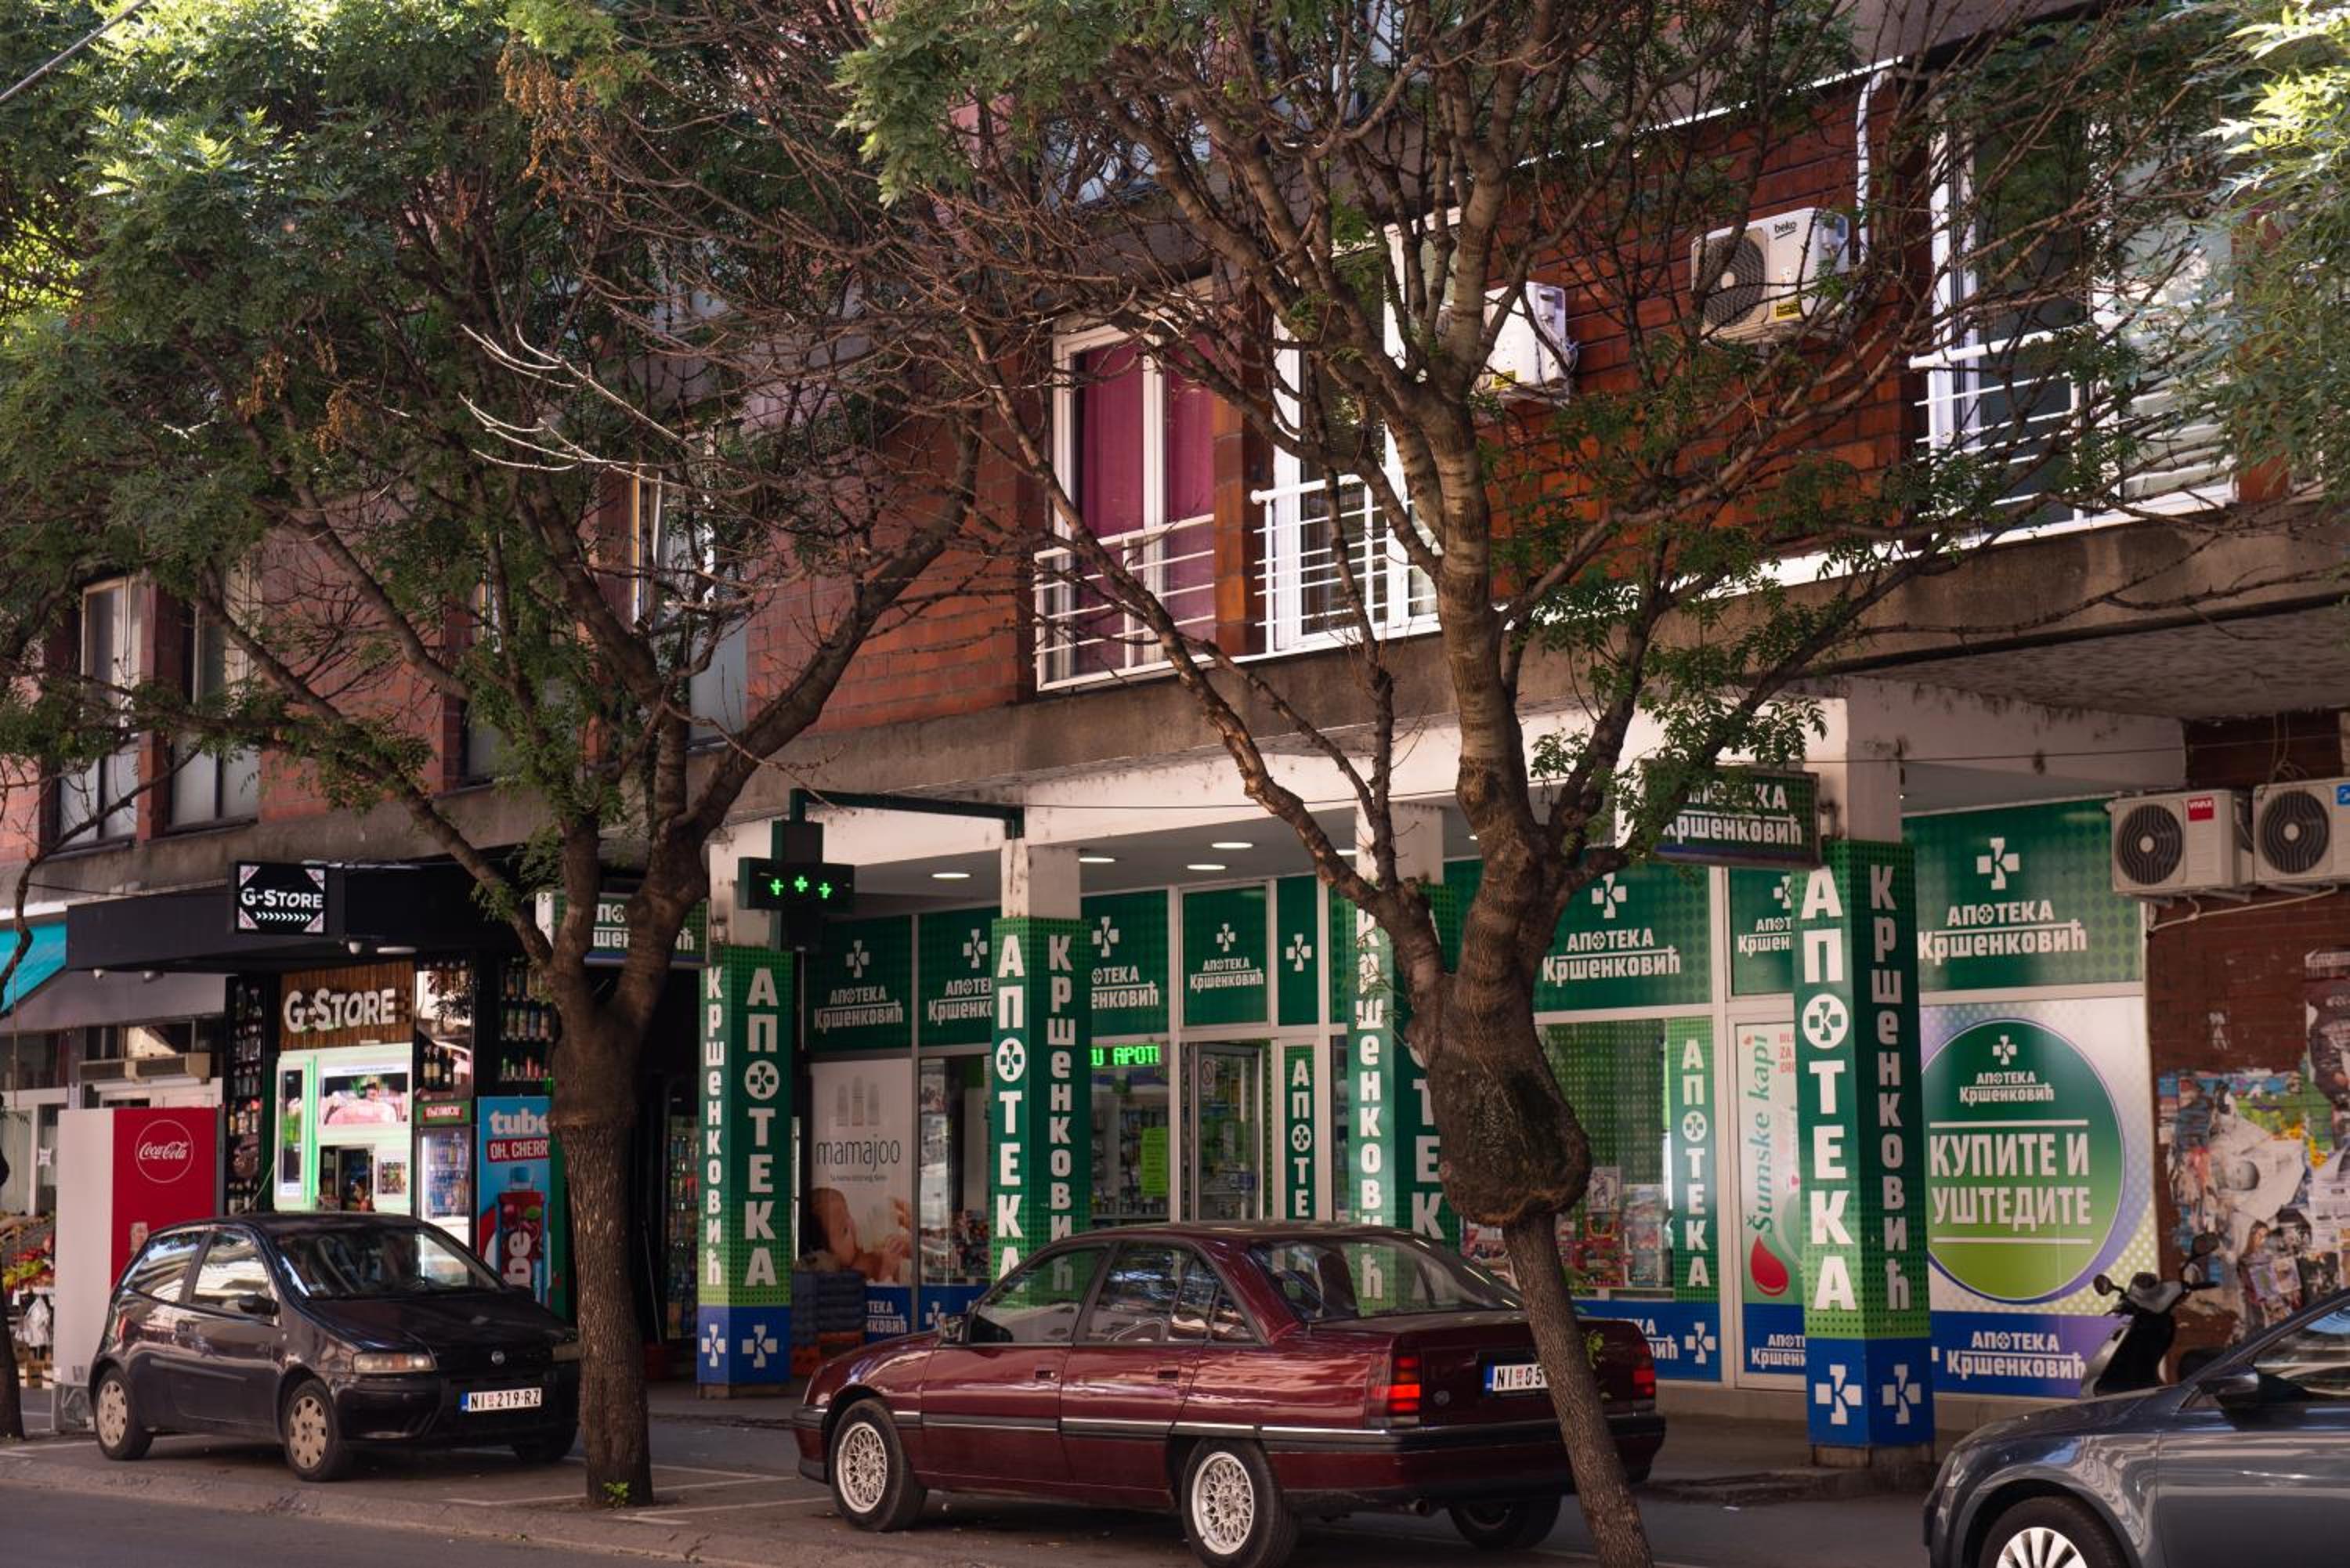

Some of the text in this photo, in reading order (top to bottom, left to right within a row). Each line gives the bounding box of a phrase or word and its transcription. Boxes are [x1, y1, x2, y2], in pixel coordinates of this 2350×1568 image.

[1774, 221, 1797, 233] beko
[240, 887, 324, 908] G-STORE
[1755, 917, 1792, 932] АПОТ
[1947, 900, 2055, 927] АПОТЕКА
[1567, 928, 1654, 952] АПОТЕКА
[1918, 919, 2087, 965] Кршенковић
[1091, 965, 1140, 985] ОТЕКА
[1202, 956, 1250, 971] АПОТЕКА
[1542, 945, 1680, 987] Кршенковић
[945, 977, 992, 995] АПОТЕ
[1190, 966, 1264, 993] Кршенковић
[830, 985, 887, 1004] АПОТЕКА
[1091, 980, 1159, 1010] енковић
[284, 988, 396, 1033] G-STORE
[815, 999, 903, 1034] Кршенковић
[1747, 1034, 1776, 1101] kapi
[1976, 1071, 2036, 1085] АПОТЕКА
[1802, 865, 1856, 1310] АПОТЕКА
[1870, 863, 1911, 1310] Кршенковић
[1959, 1082, 2055, 1107] Кршенковић
[705, 966, 725, 1286] Кршенковић
[744, 967, 780, 1287] АПОТЕКА
[1292, 1058, 1312, 1217] АПОТЕ
[512, 1140, 549, 1158] CHERR
[815, 1133, 901, 1173] mamajoo
[1929, 1133, 2089, 1177] КУПИТЕ И
[1682, 1039, 1710, 1287] АПОТЕКА
[1931, 1186, 2092, 1232] УШТЕДИТЕ
[1768, 1334, 1805, 1348] АПОТ
[1971, 1331, 2060, 1352] АПОТЕКА
[1497, 1368, 1512, 1388] NI
[1947, 1352, 2086, 1381] Кршенковић
[471, 1394, 485, 1409] NI
